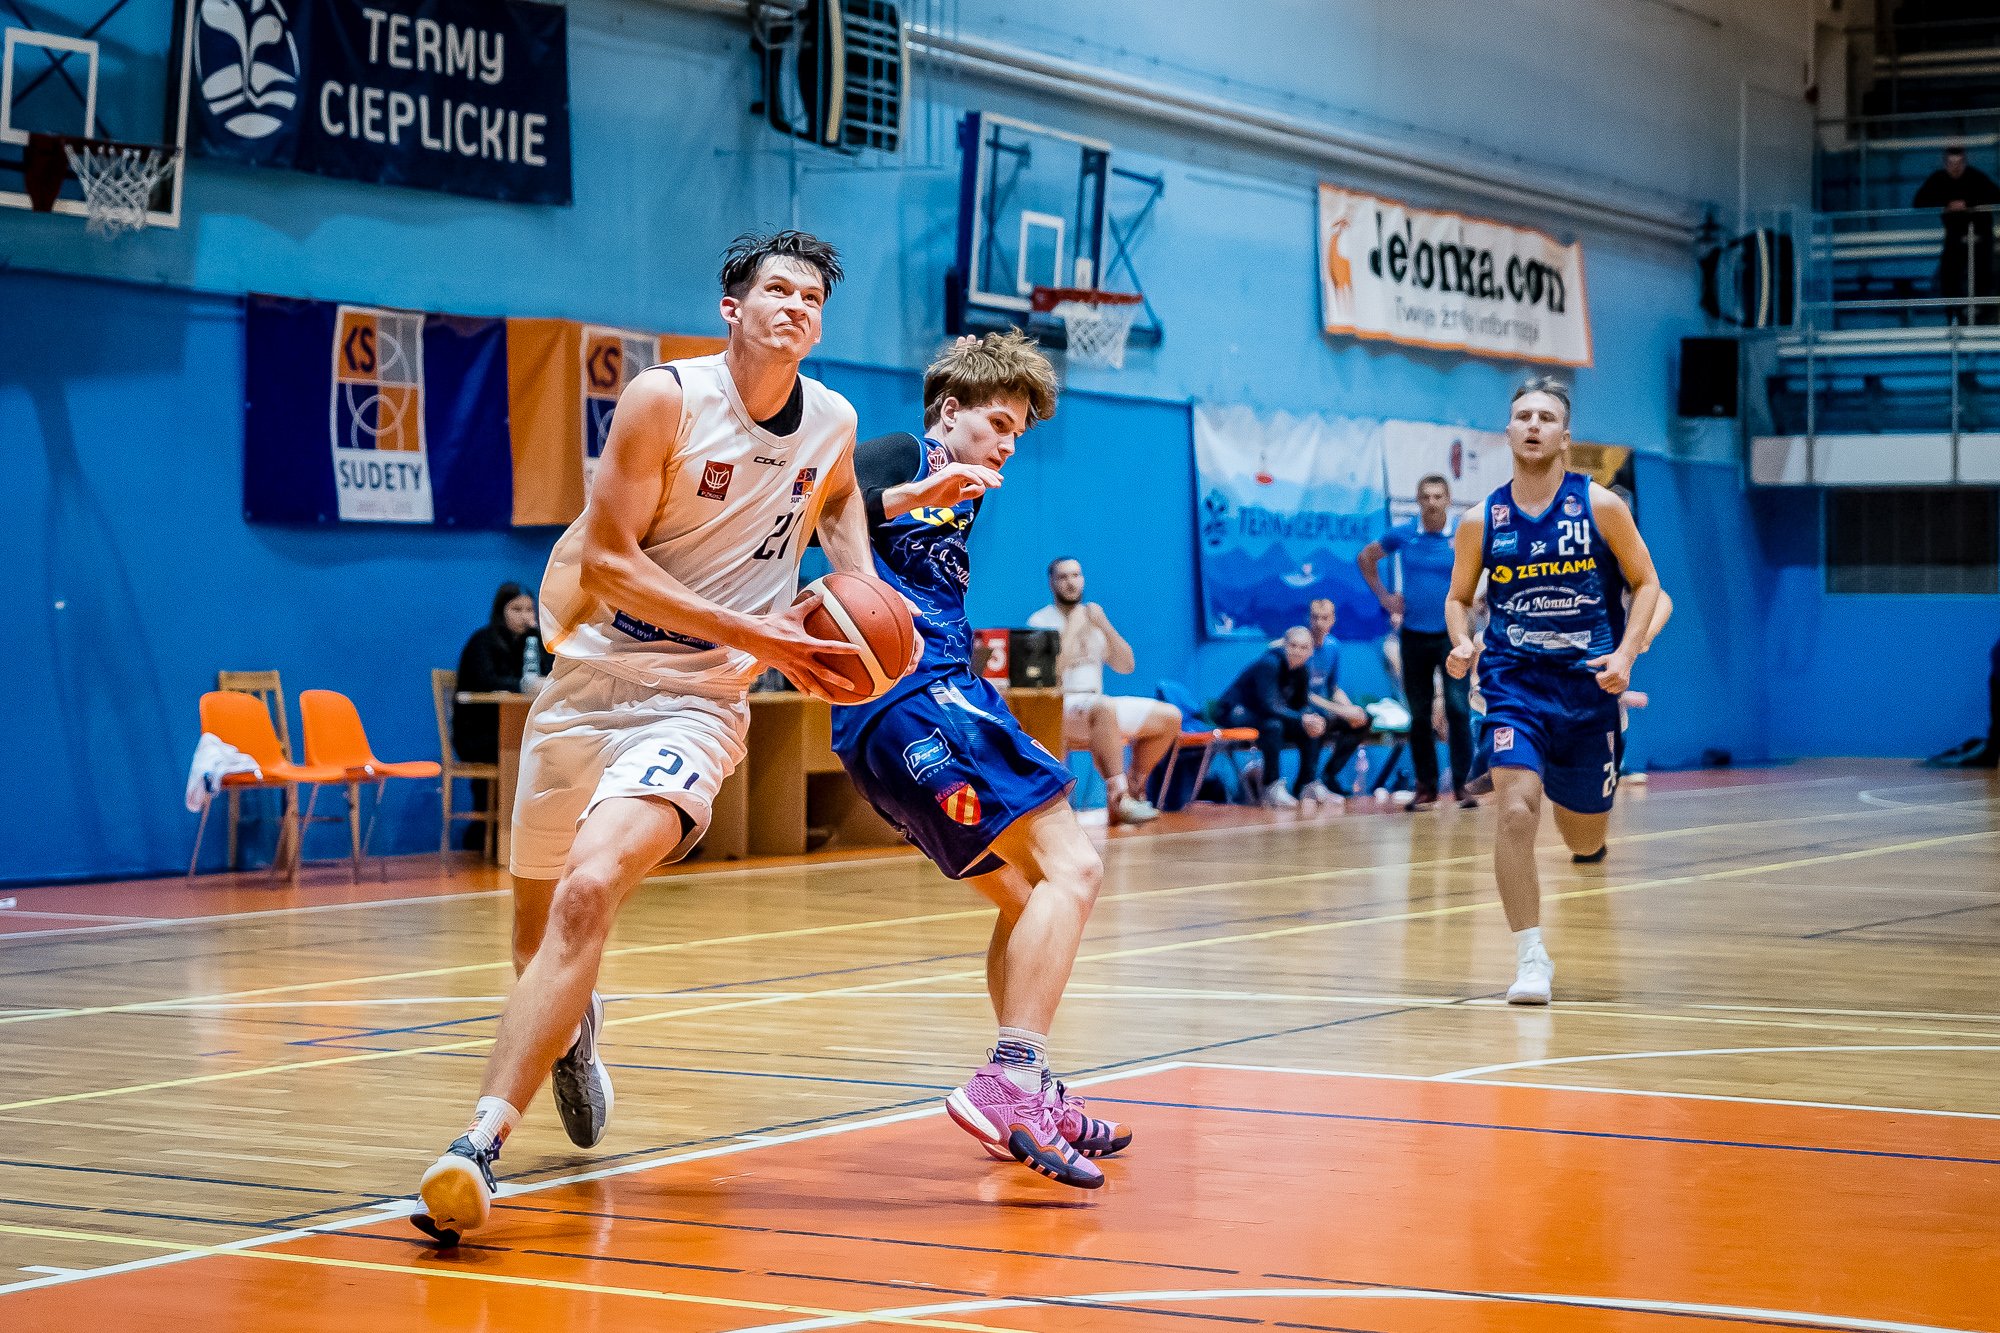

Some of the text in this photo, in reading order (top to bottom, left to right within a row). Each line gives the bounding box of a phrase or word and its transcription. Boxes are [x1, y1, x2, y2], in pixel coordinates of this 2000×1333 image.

[362, 7, 505, 85] TERMY
[319, 80, 548, 167] CIEPLICKIE
[338, 459, 423, 492] SUDETY
[752, 509, 806, 561] 21
[1557, 518, 1592, 557] 24
[1516, 557, 1597, 580] ZETKAMA
[1515, 595, 1573, 612] La Nonna
[638, 748, 701, 791] 21
